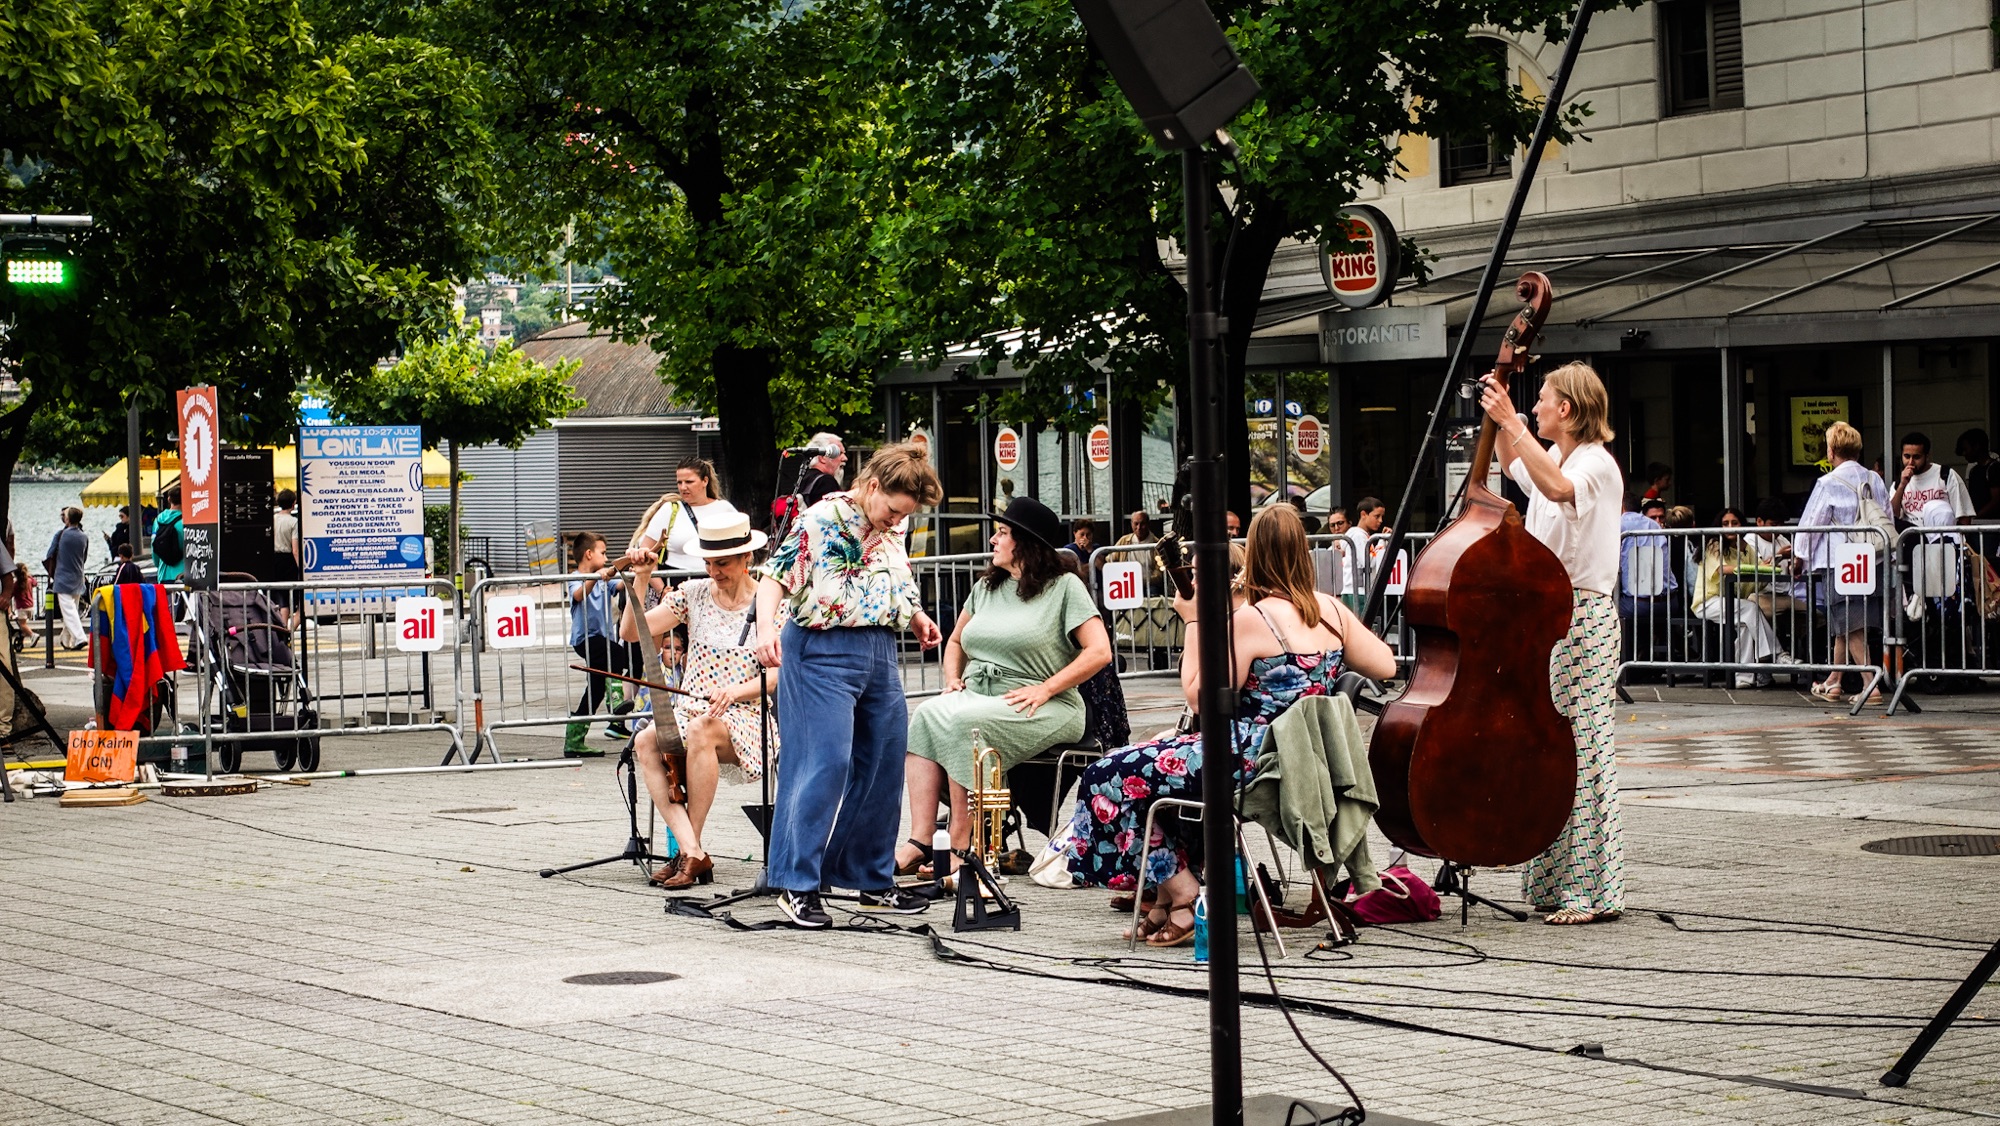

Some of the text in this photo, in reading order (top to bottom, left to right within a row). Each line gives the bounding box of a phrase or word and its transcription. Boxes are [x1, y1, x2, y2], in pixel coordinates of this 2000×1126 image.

[1332, 256, 1376, 279] KING
[394, 428, 417, 436] JULY
[193, 427, 201, 469] 1
[303, 437, 419, 456] LONGLAKE
[999, 449, 1016, 458] KING
[1091, 446, 1109, 456] KING
[1298, 439, 1319, 448] KING
[1387, 560, 1401, 584] il
[1841, 554, 1868, 584] ail
[1109, 572, 1135, 600] ail
[403, 609, 435, 639] ail
[497, 606, 529, 638] ail
[72, 737, 133, 748] Cho Kairin
[87, 756, 112, 770] (CN)
